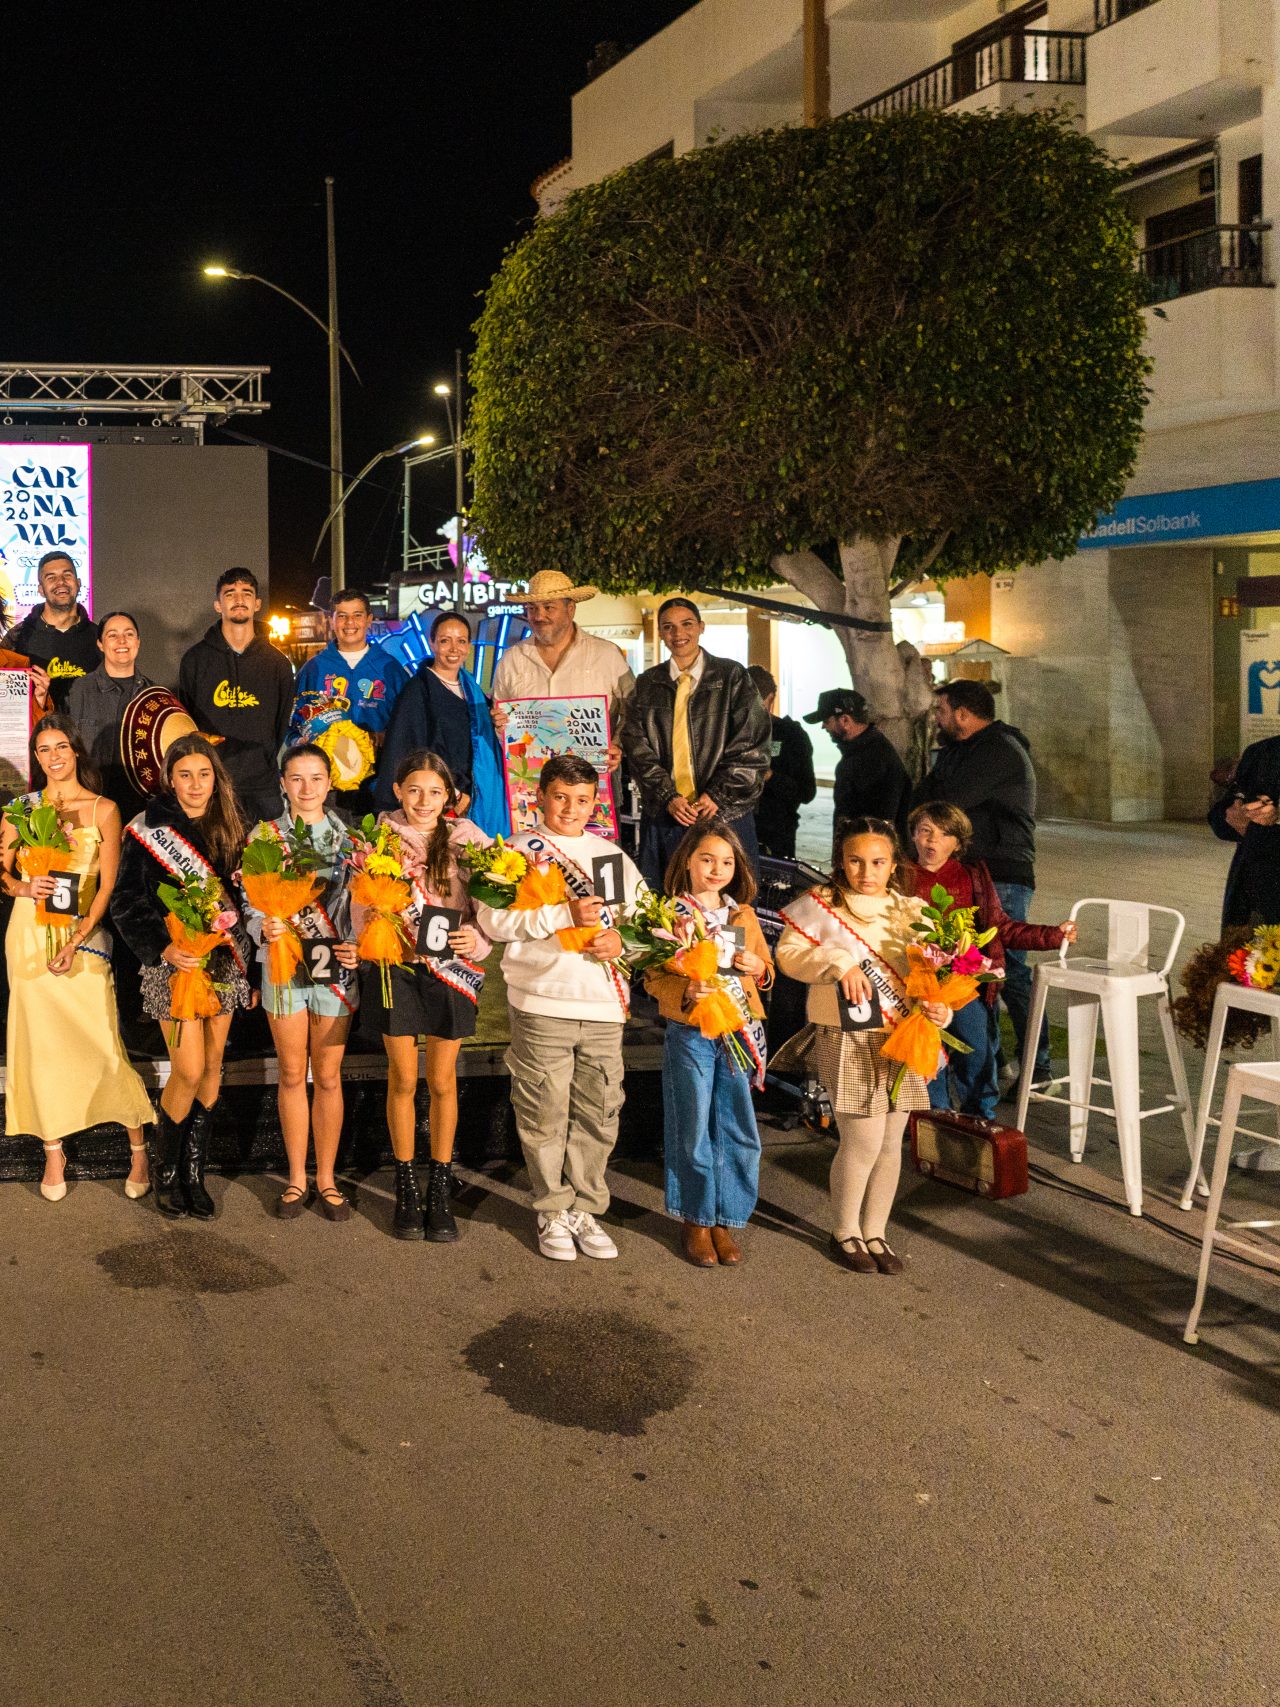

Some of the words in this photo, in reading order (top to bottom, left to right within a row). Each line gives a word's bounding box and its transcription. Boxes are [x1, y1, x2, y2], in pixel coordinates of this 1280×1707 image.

[12, 465, 79, 488] CAR
[3, 489, 30, 504] 20
[33, 494, 79, 517] NA
[6, 507, 29, 521] 26
[13, 523, 77, 546] VAL
[487, 604, 525, 618] games
[324, 676, 350, 698] 19
[357, 678, 386, 701] 92
[570, 707, 602, 720] CAR
[580, 722, 602, 734] NA
[573, 735, 603, 747] VAL
[599, 862, 615, 901] 1
[52, 877, 72, 910] 5
[425, 915, 450, 951] 6
[310, 944, 332, 979] 2
